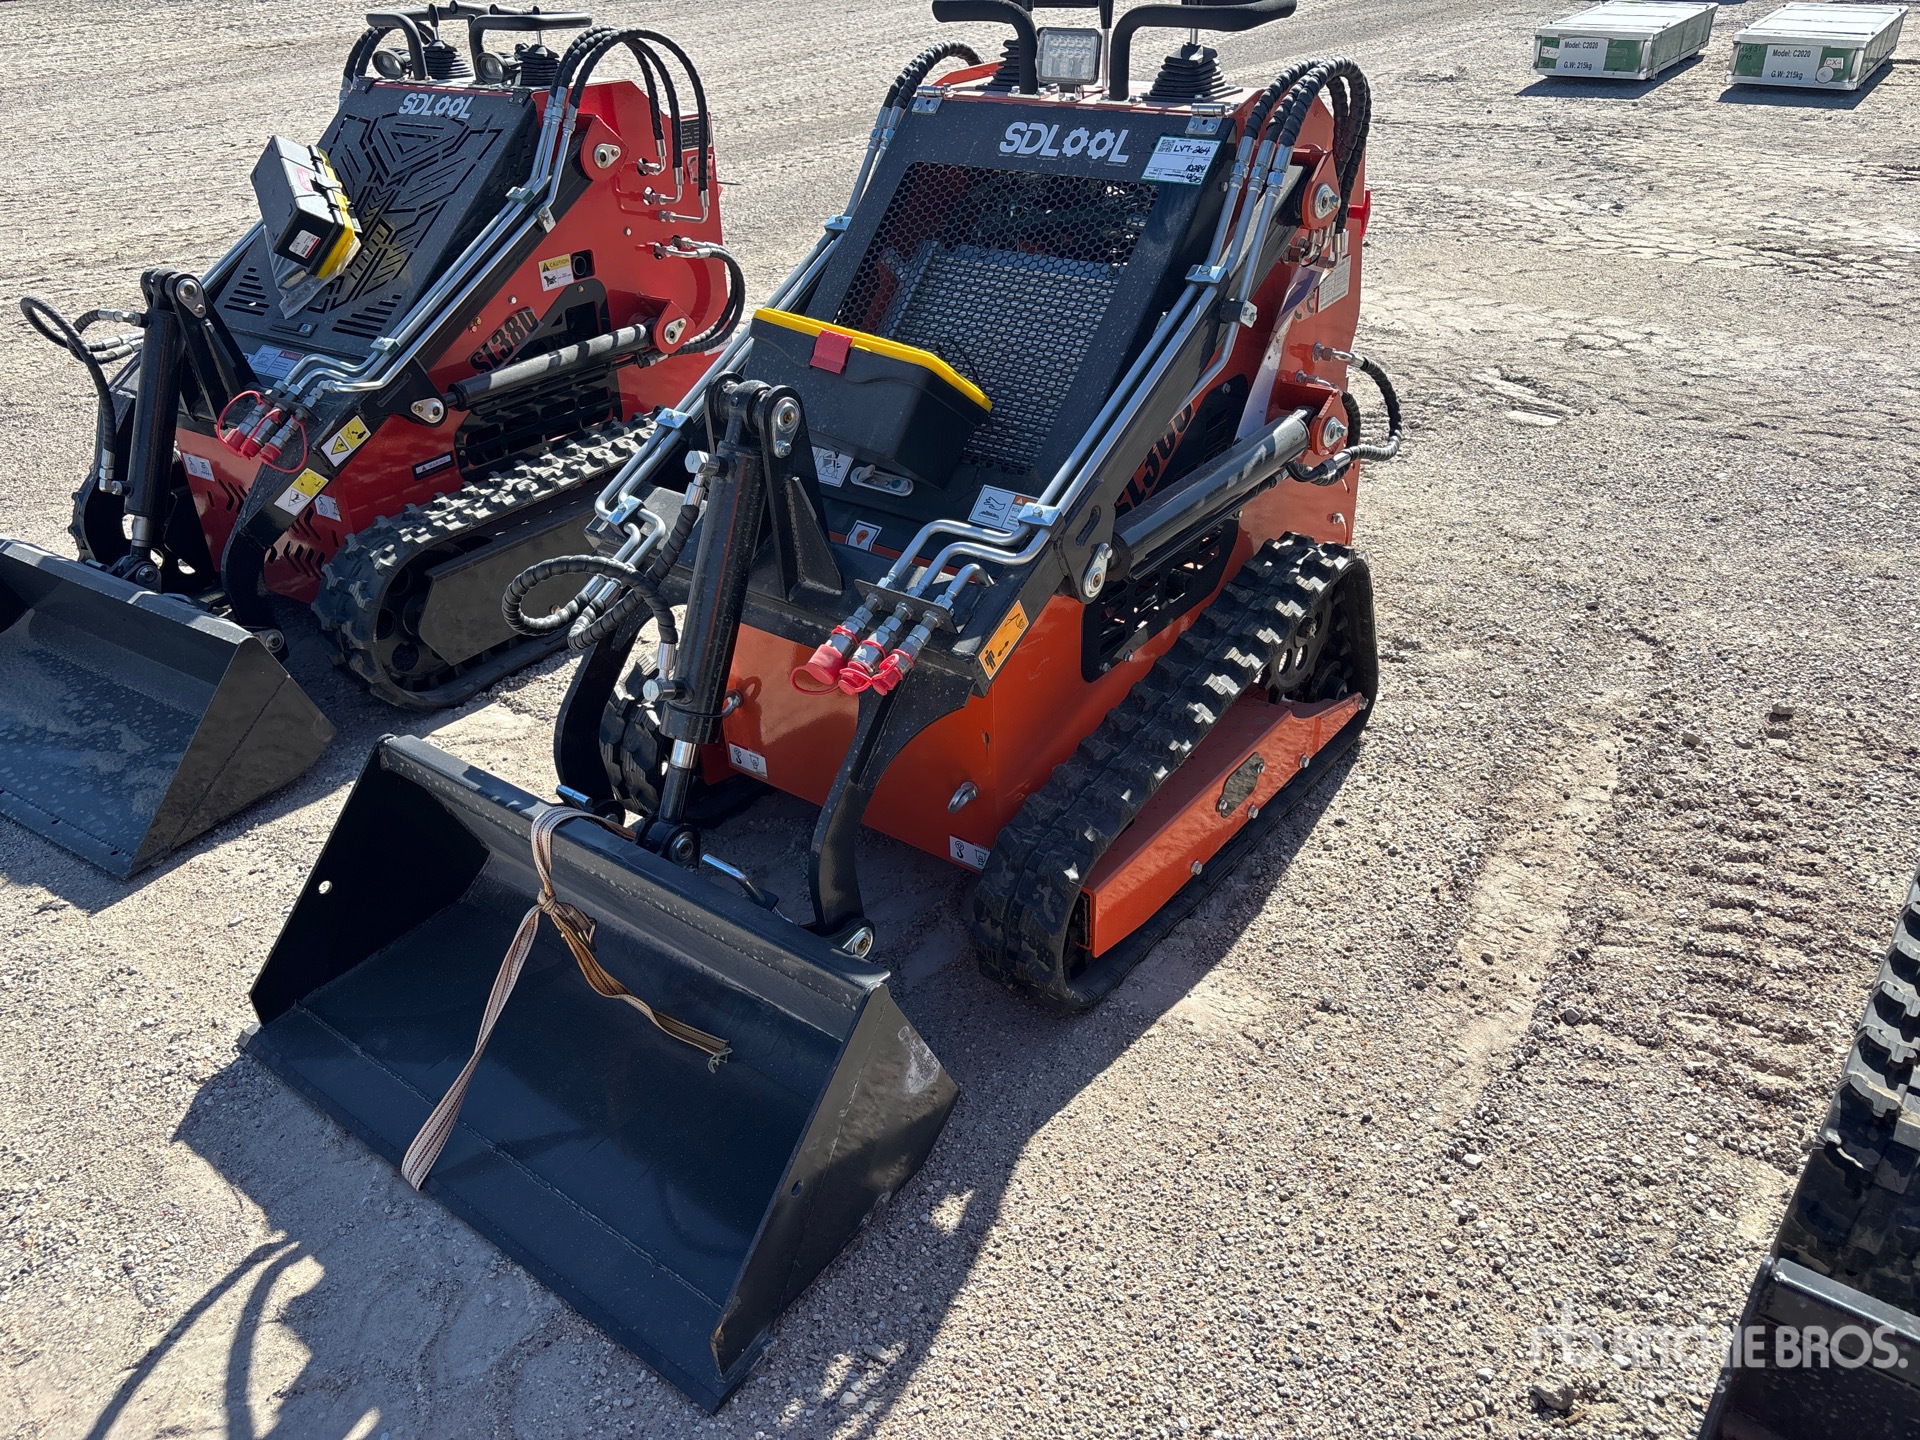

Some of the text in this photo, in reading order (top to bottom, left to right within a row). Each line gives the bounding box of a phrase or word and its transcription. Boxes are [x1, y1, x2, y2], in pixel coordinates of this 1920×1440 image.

[1564, 41, 1582, 49] Model:
[1772, 49, 1812, 58] Model: C2020
[1577, 62, 1593, 70] 215kg
[1786, 71, 1804, 80] 215kg
[398, 92, 474, 119] SDLOOL
[999, 121, 1129, 163] SDLOOL
[550, 258, 570, 268] CAUTION
